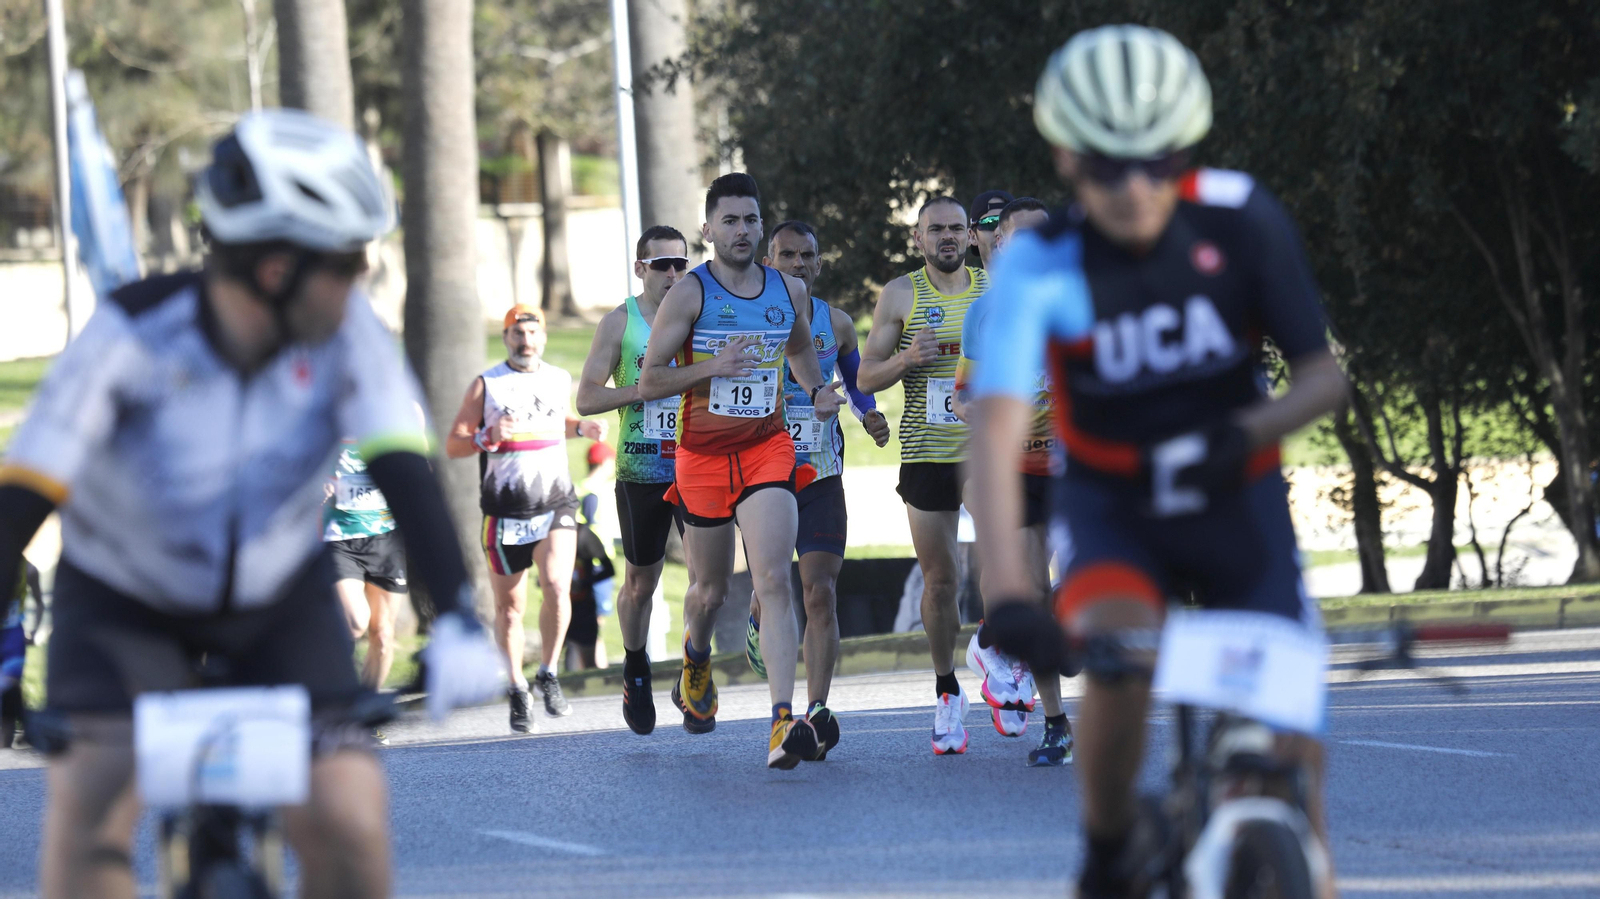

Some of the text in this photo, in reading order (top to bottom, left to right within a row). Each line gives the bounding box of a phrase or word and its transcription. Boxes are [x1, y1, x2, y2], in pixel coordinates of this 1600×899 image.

[1095, 295, 1235, 383] UCA
[731, 386, 752, 406] 19
[727, 408, 760, 416] EVOS
[625, 442, 658, 455] 226ERS
[349, 486, 372, 500] 165
